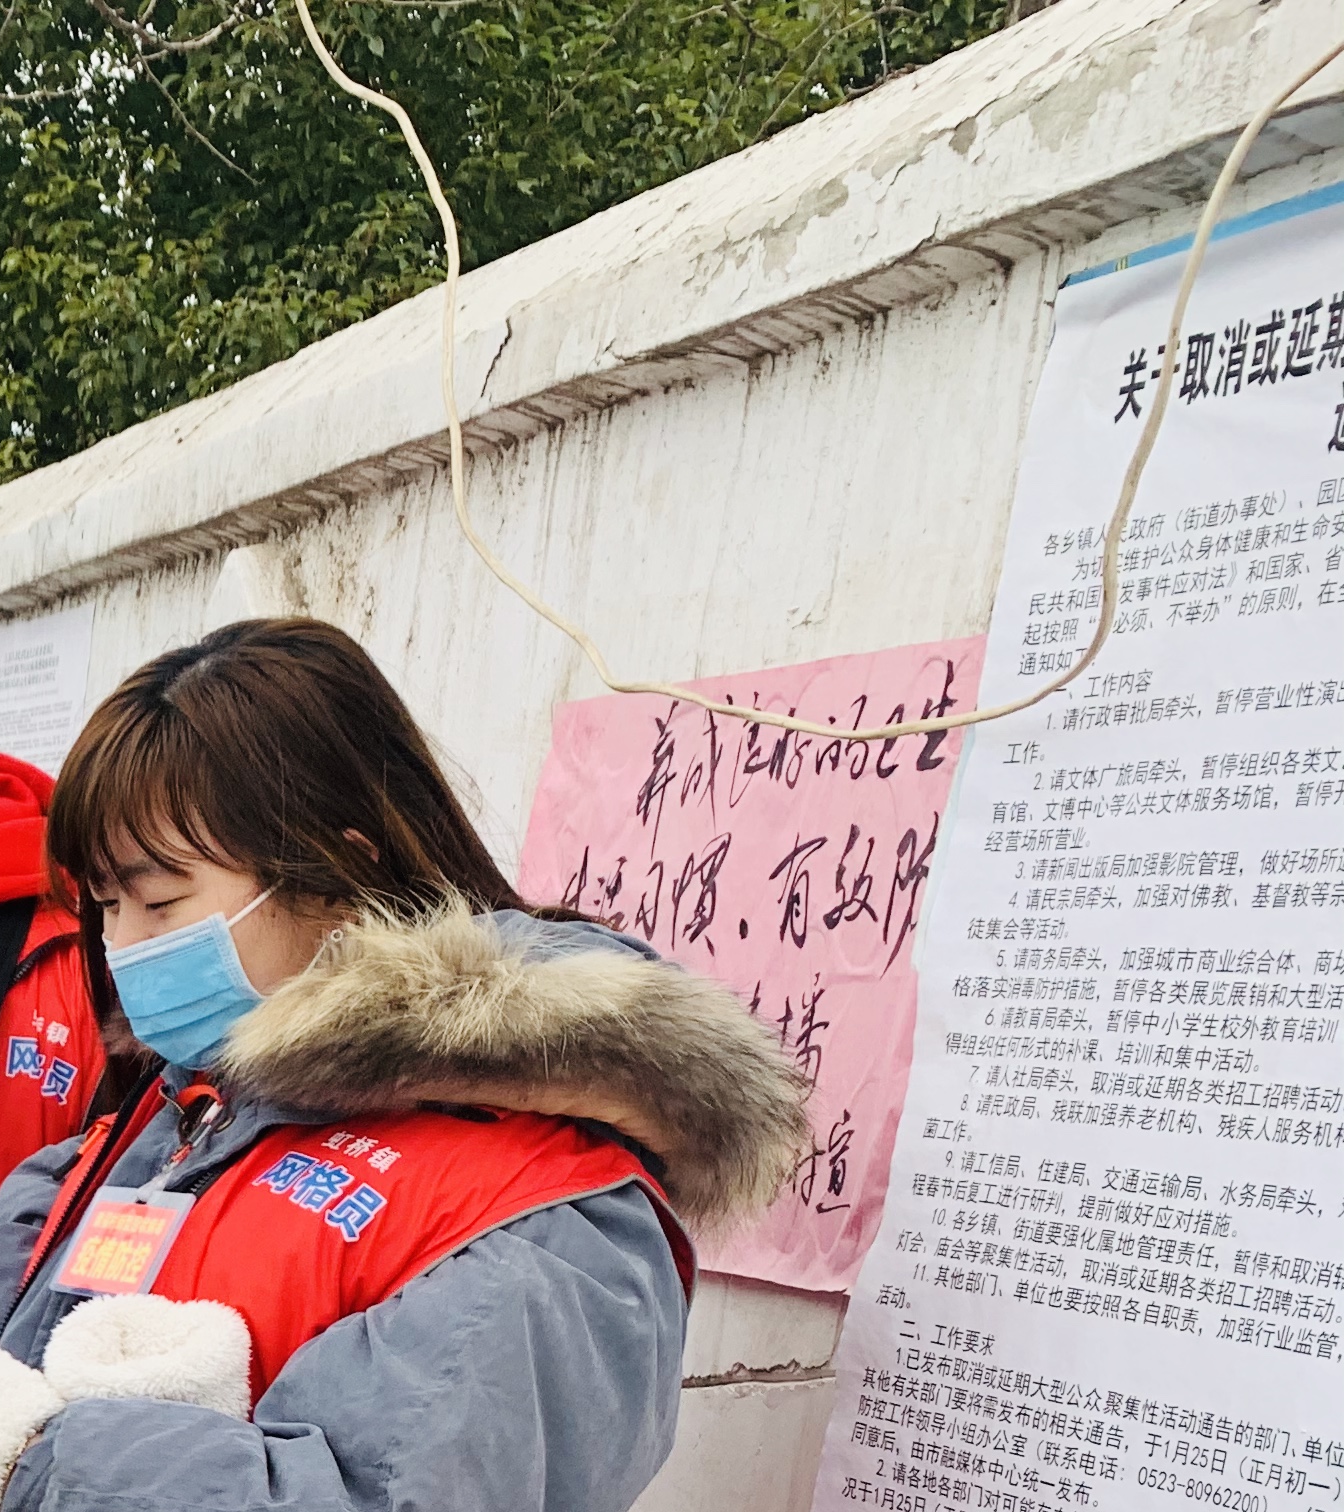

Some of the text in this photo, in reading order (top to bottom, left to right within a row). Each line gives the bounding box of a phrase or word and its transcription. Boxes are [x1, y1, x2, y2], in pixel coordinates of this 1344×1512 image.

[1028, 544, 1344, 616] 民共和国发事件应对法》和国家、省
[1002, 740, 1046, 764] 工作。
[984, 826, 1092, 852] 经营场所营业。
[967, 917, 1069, 940] 徒集会等活动。
[6, 1035, 78, 1105] 网员
[923, 1118, 974, 1142] 菌工作。
[321, 1131, 402, 1173] 虹桥镇
[252, 1151, 387, 1242] 网格员
[945, 1150, 1344, 1218] 9.请工信局、住建局、交通运输局、水务局牵头，
[875, 1284, 913, 1310] 活动。
[899, 1319, 996, 1357] 二、工作要求
